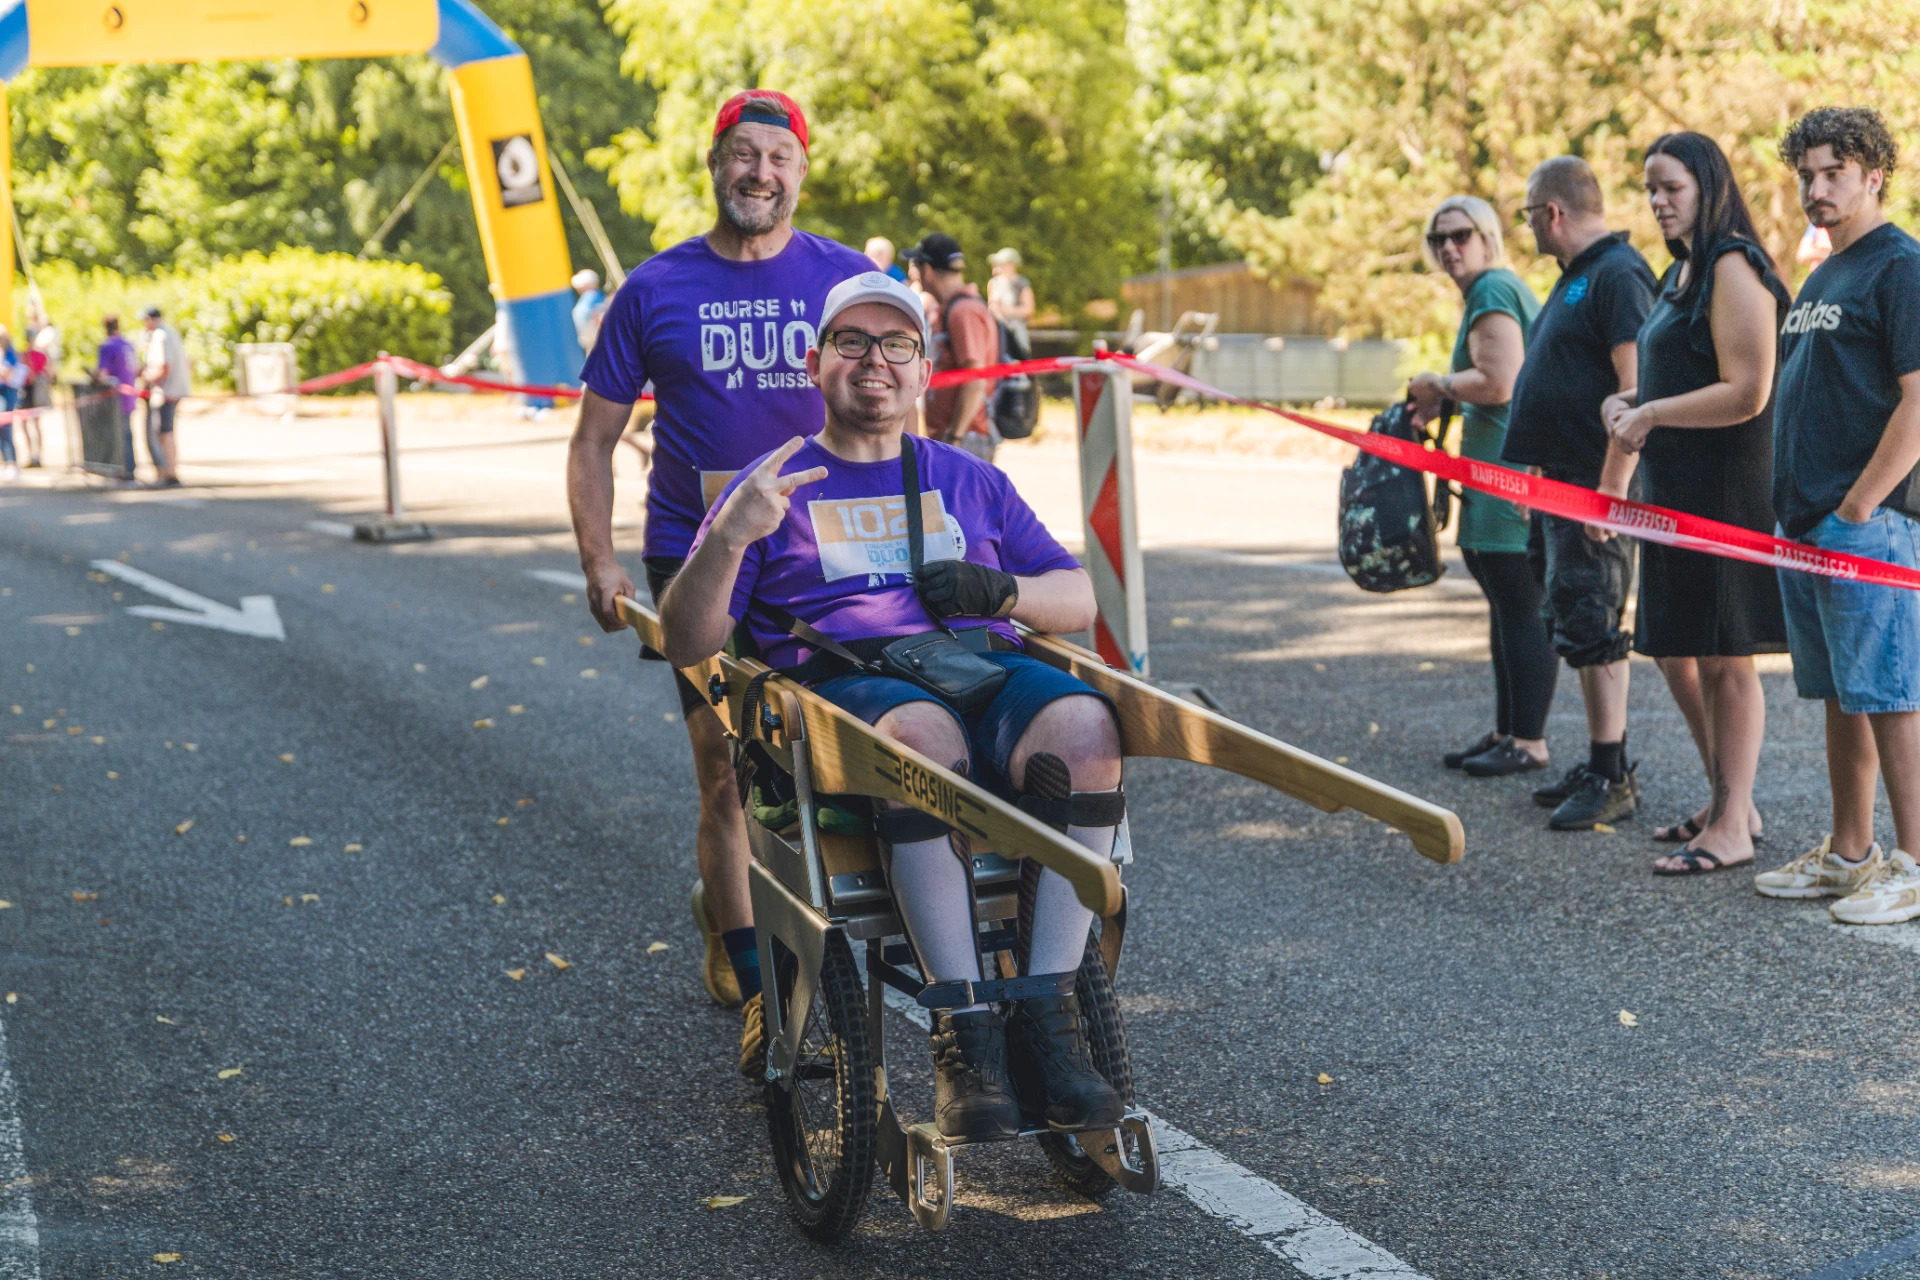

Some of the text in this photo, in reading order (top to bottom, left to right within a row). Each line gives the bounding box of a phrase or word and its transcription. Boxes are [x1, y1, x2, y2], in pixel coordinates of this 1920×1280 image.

[699, 299, 780, 320] COURSE
[1781, 300, 1842, 335] dias
[701, 320, 817, 371] DUO
[1470, 463, 1529, 496] RAIFFEISEN
[837, 501, 908, 539] 102
[1608, 502, 1678, 534] RAIFFEISEN
[867, 547, 909, 563] DUO
[1772, 544, 1859, 579] RAIFFEISEN
